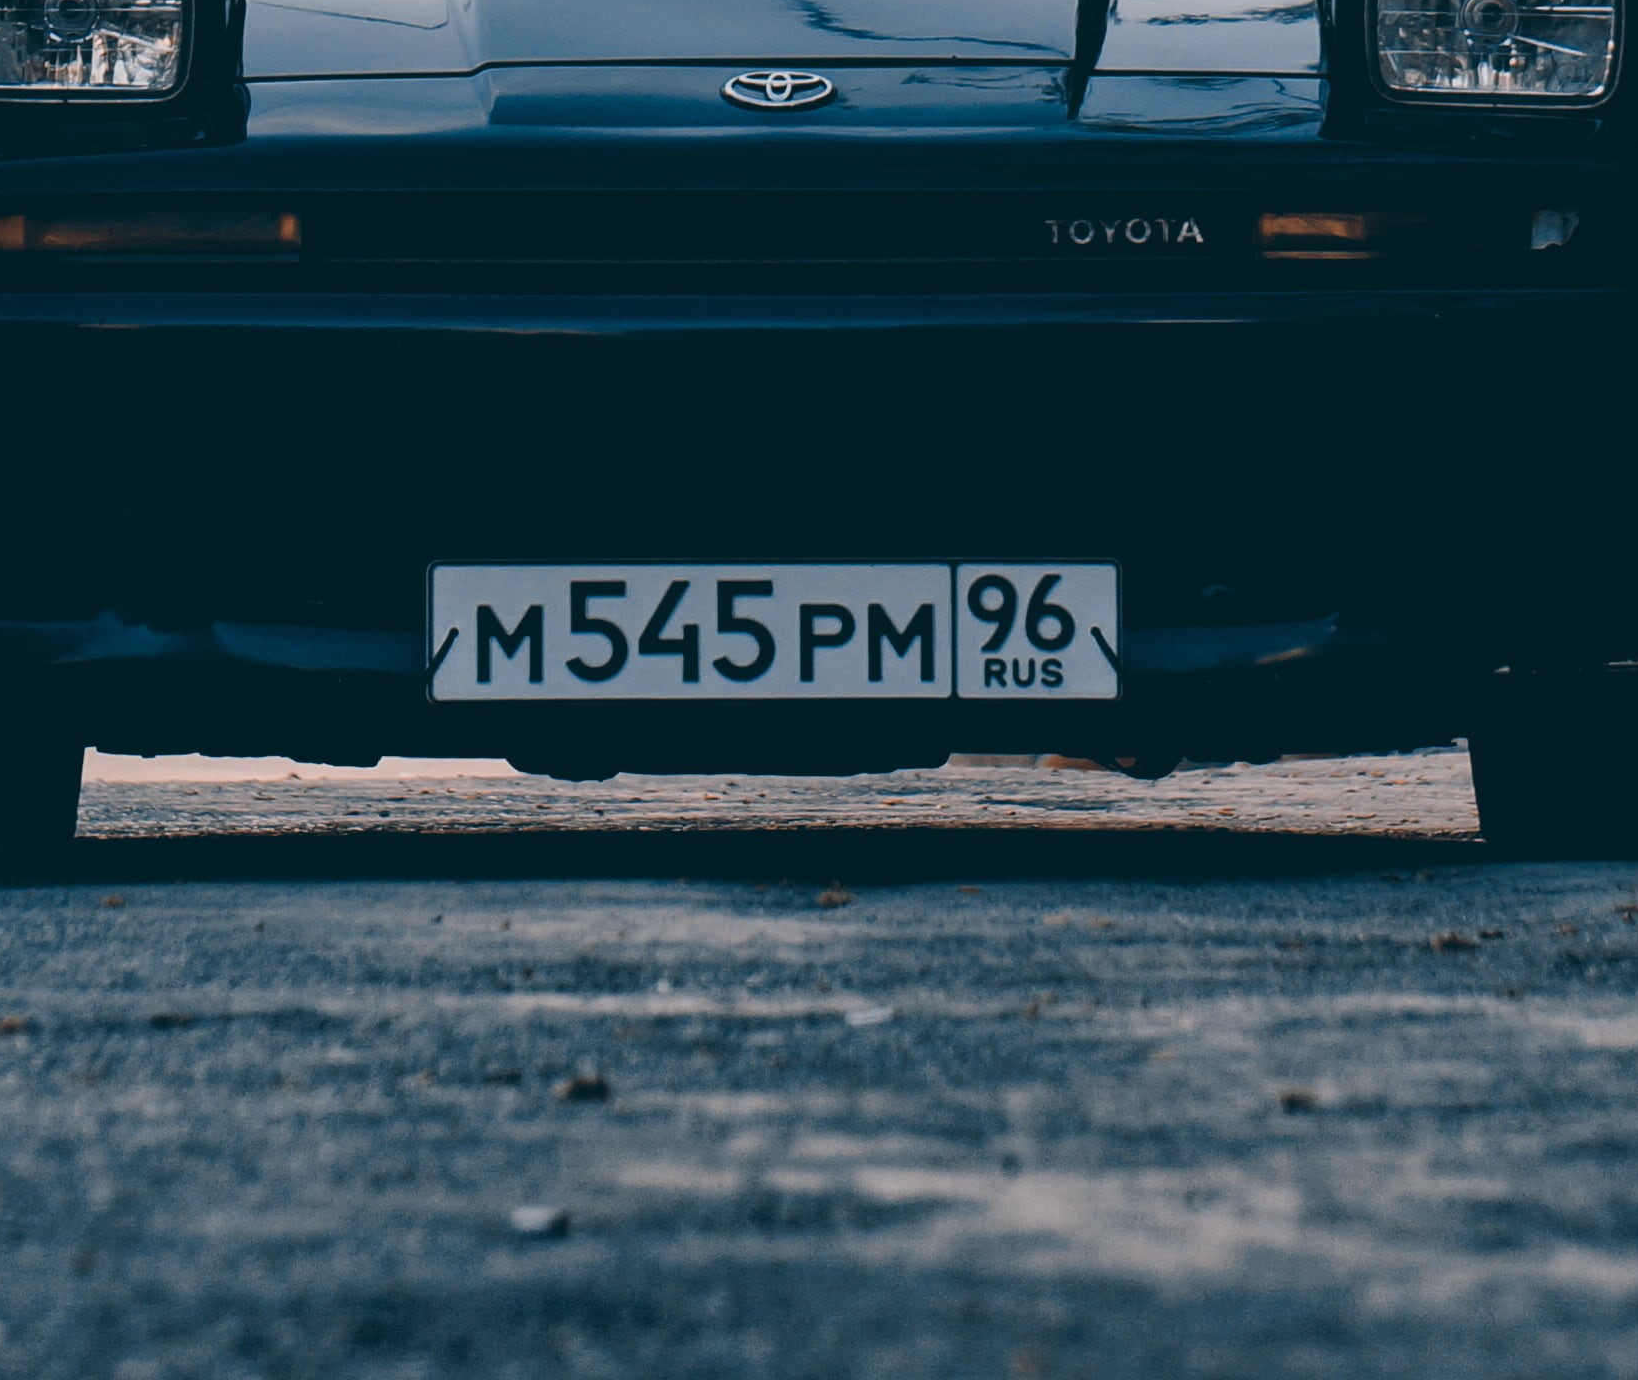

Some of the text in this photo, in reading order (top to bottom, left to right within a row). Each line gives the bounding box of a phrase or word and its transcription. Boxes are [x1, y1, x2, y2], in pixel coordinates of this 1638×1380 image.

[1044, 217, 1205, 245] TOYOTA
[966, 573, 1077, 654] 96
[983, 657, 1065, 689] RUS
